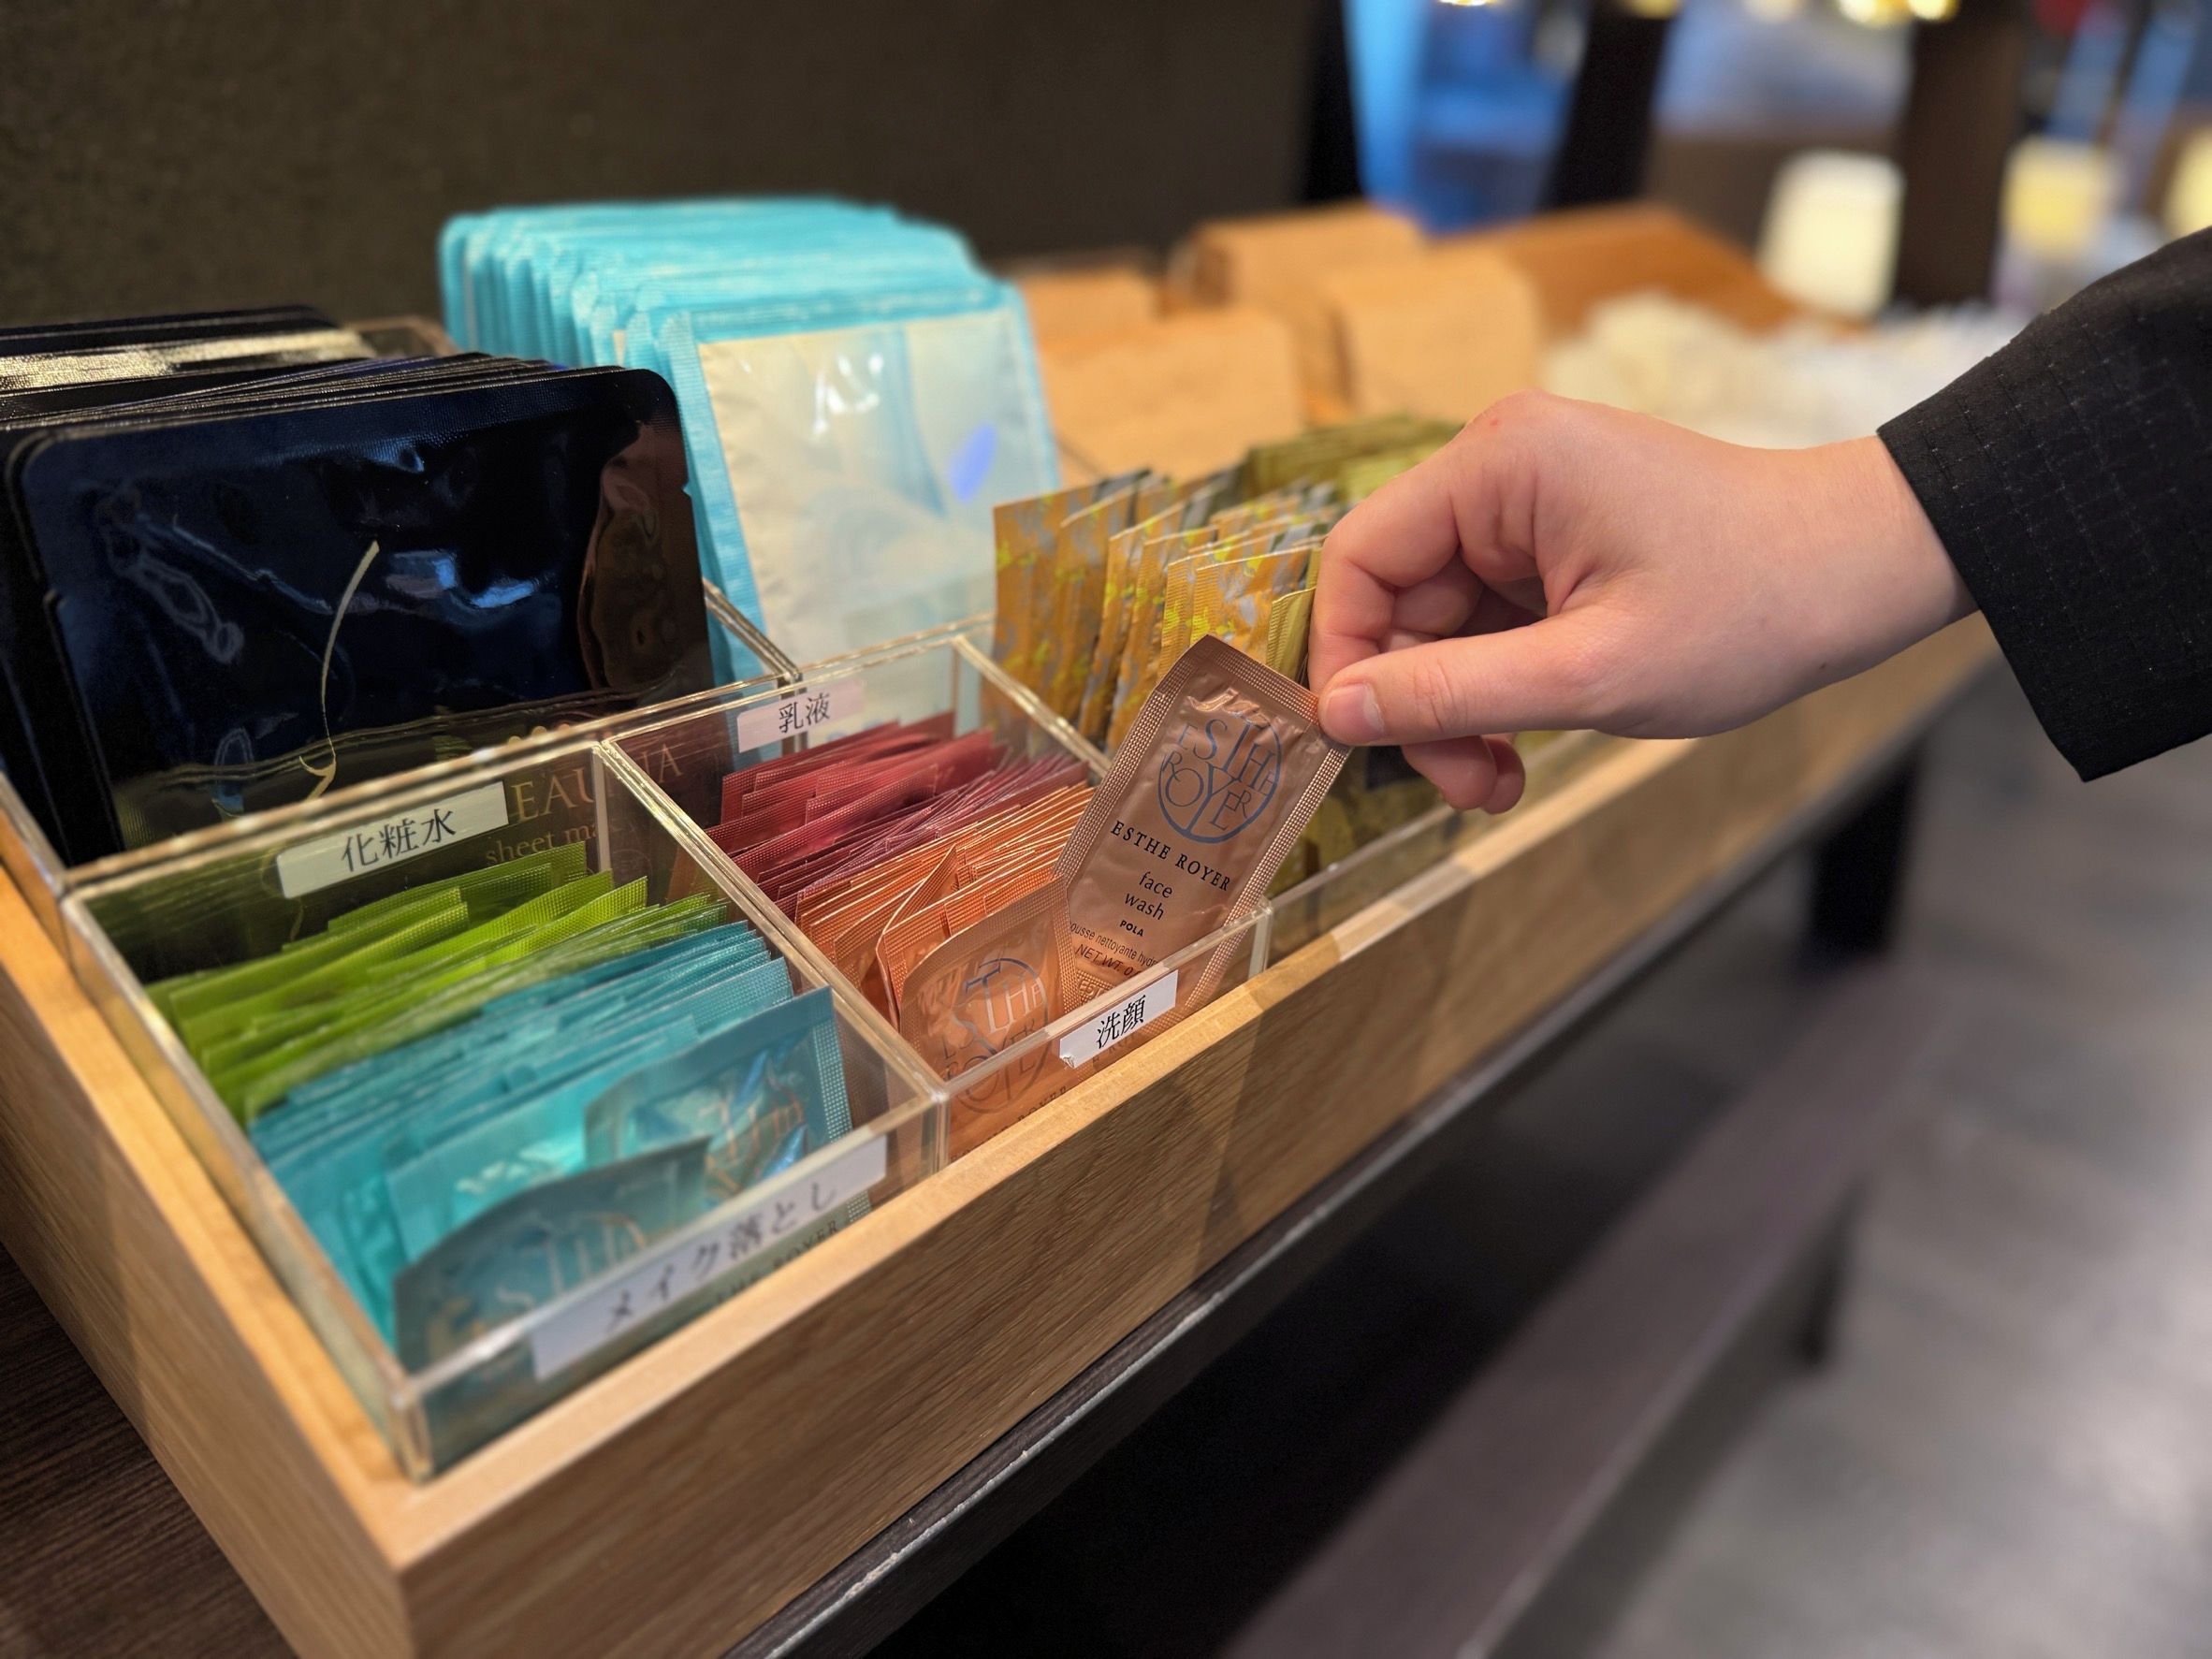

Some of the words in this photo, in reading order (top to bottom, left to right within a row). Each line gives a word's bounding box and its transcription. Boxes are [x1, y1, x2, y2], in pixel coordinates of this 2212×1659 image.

[779, 692, 830, 734] 乳液
[341, 808, 457, 873] 化粧水
[485, 832, 555, 866] sheet
[1110, 820, 1171, 860] ESTHE
[1175, 853, 1231, 892] ROYER
[1138, 870, 1173, 898] face
[1125, 893, 1165, 921] wash
[1070, 922, 1096, 939] ousse
[1096, 934, 1138, 961] nettoyante
[1119, 920, 1144, 938] POLA
[1075, 943, 1102, 964] NET
[1096, 995, 1147, 1049] 洗顔
[604, 1181, 837, 1332] メイク落とし
